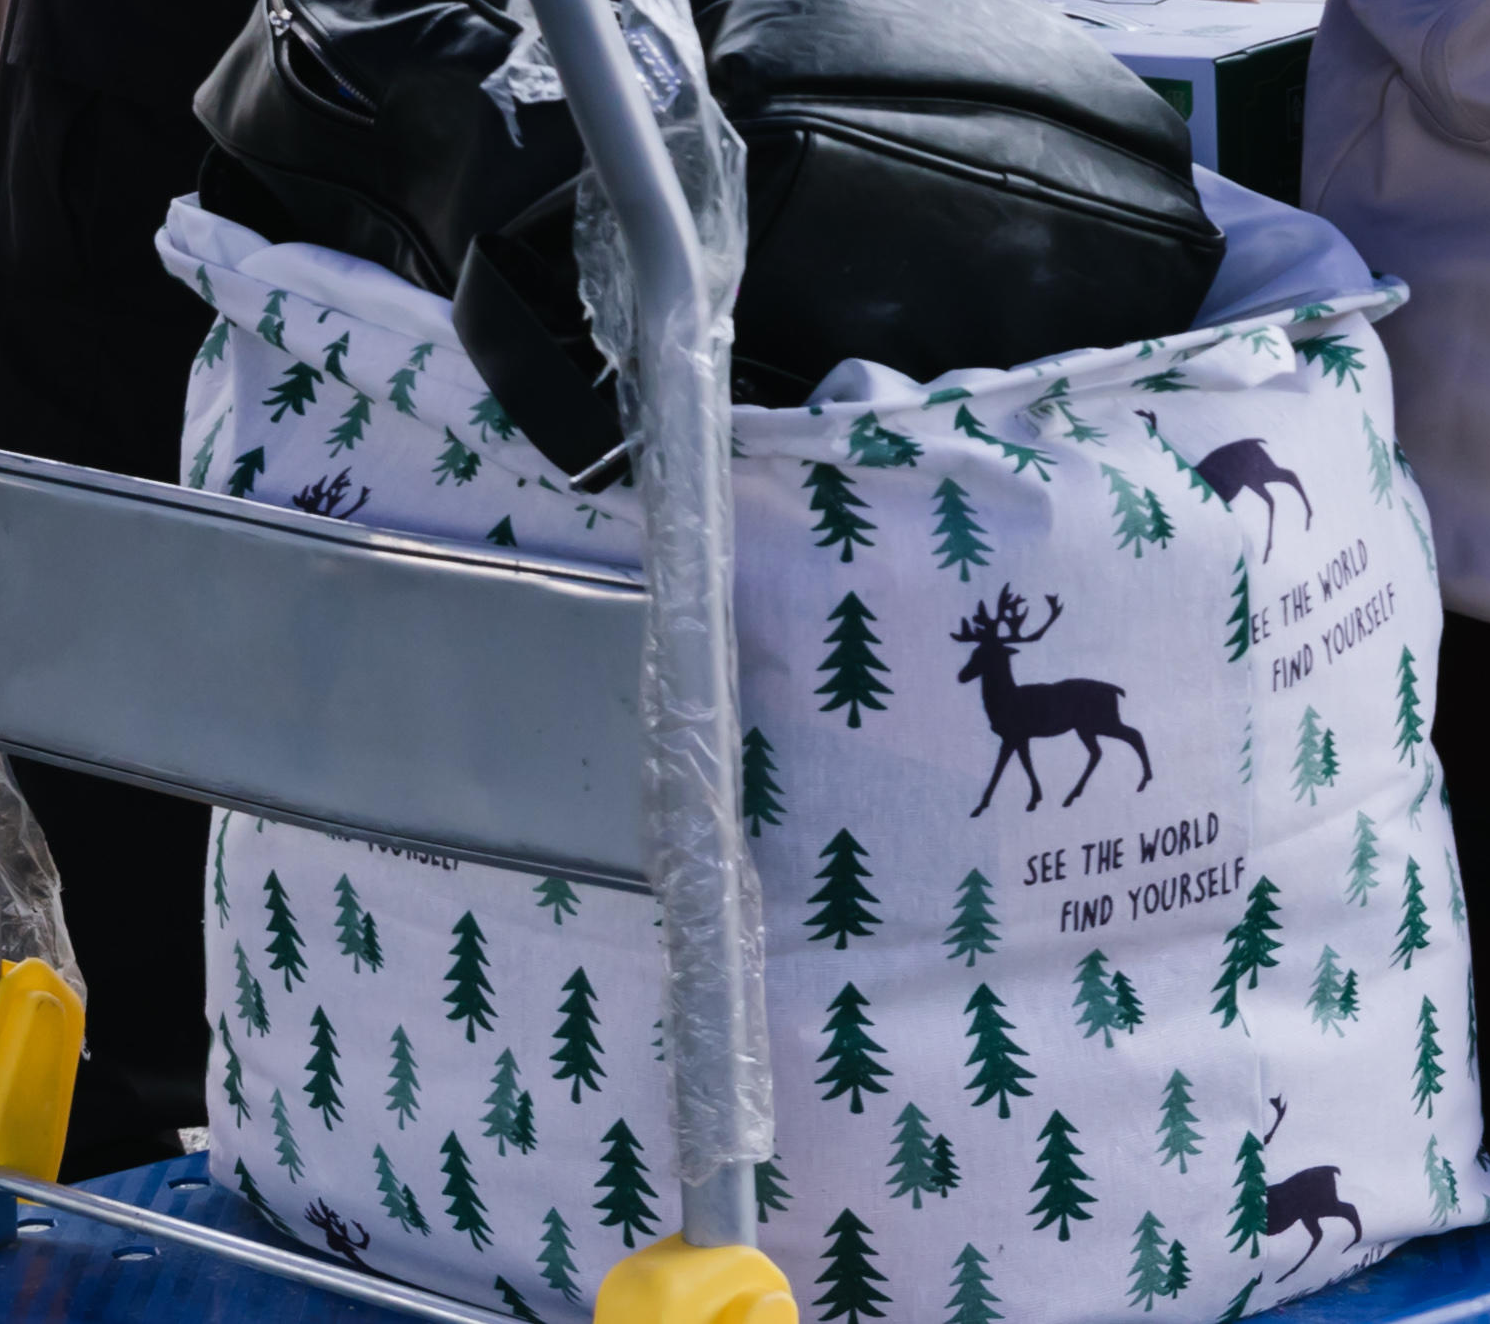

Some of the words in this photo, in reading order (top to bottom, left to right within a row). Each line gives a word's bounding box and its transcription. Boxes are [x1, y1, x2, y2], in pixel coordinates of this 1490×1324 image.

[1251, 613, 1272, 647] EE
[1280, 581, 1313, 628] THE
[1316, 537, 1370, 602] WORLD
[1271, 642, 1316, 695] FIND
[1320, 582, 1398, 667] YOURSELF
[1022, 849, 1068, 889] SEE
[1080, 835, 1125, 875] THE
[1139, 811, 1221, 865] WORLD
[1060, 897, 1115, 935] FIND
[1129, 857, 1248, 922] YOURSELF
